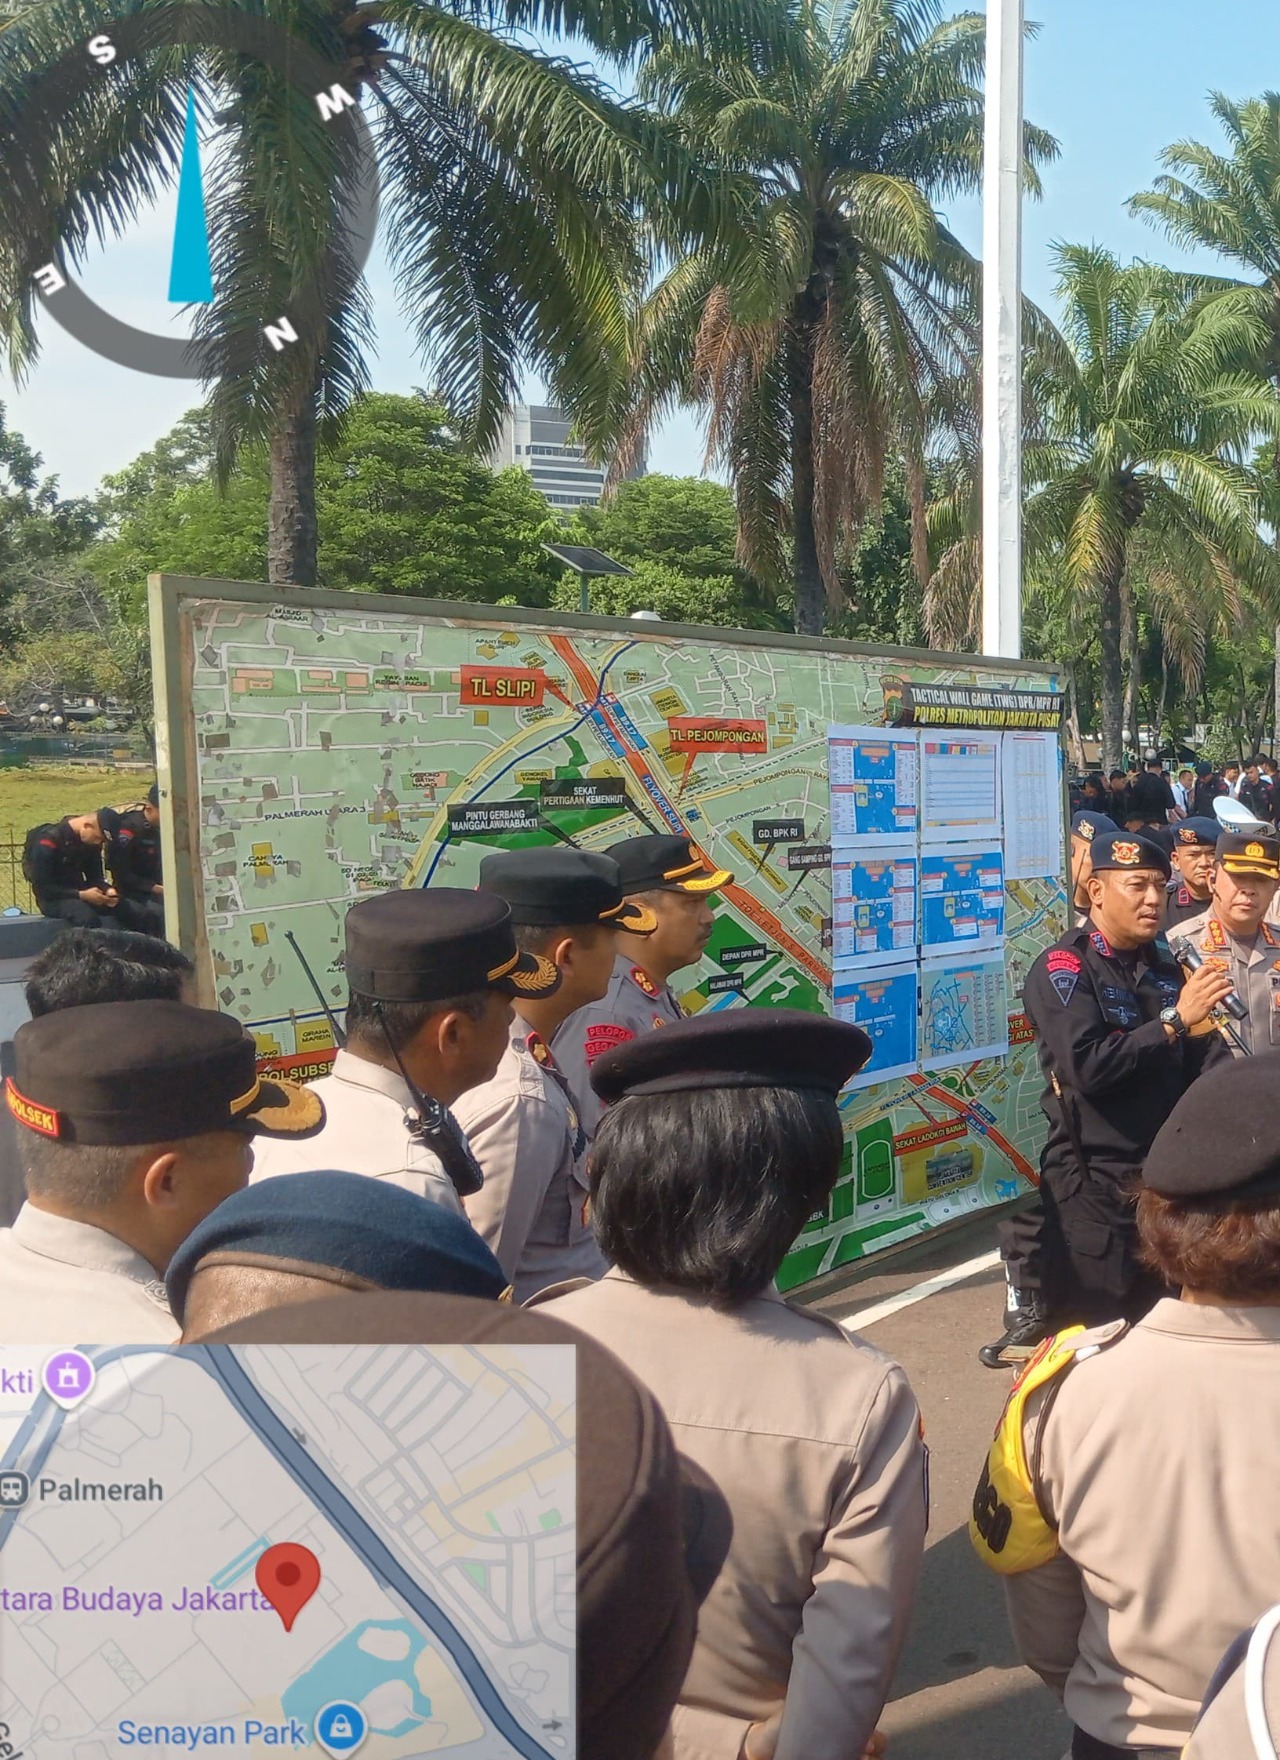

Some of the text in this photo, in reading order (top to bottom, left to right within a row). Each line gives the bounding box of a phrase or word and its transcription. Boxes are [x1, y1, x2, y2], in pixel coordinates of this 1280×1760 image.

[471, 679, 536, 698] TL SLIPI
[911, 688, 950, 705] TACTICAL
[950, 690, 970, 705] WALL
[971, 692, 993, 707] GAME
[914, 706, 1061, 729] POLRES METROPOLITAN JAKARTA PUSAT
[670, 729, 766, 743] TL PEJOMPONGAN
[753, 769, 806, 785] PEJOMPONGAN
[573, 787, 598, 796] SEKAT
[544, 795, 624, 805] PERTIGAAN KEMENHUT
[264, 809, 323, 821] PALMERAH
[324, 805, 358, 816] UARA
[465, 809, 526, 821] PINTU GERBANG
[451, 818, 538, 831] MANGGALAWANABAKTI
[664, 811, 685, 833] SLIPI
[758, 830, 772, 839] GD.
[774, 828, 790, 838] BPK
[741, 901, 755, 915] TOL
[722, 952, 740, 961] DEPAN
[302, 1028, 330, 1038] GRAHA
[1015, 1029, 1034, 1041] ATAS
[895, 1122, 967, 1150] SEKAT LADOKGI BAWAH
